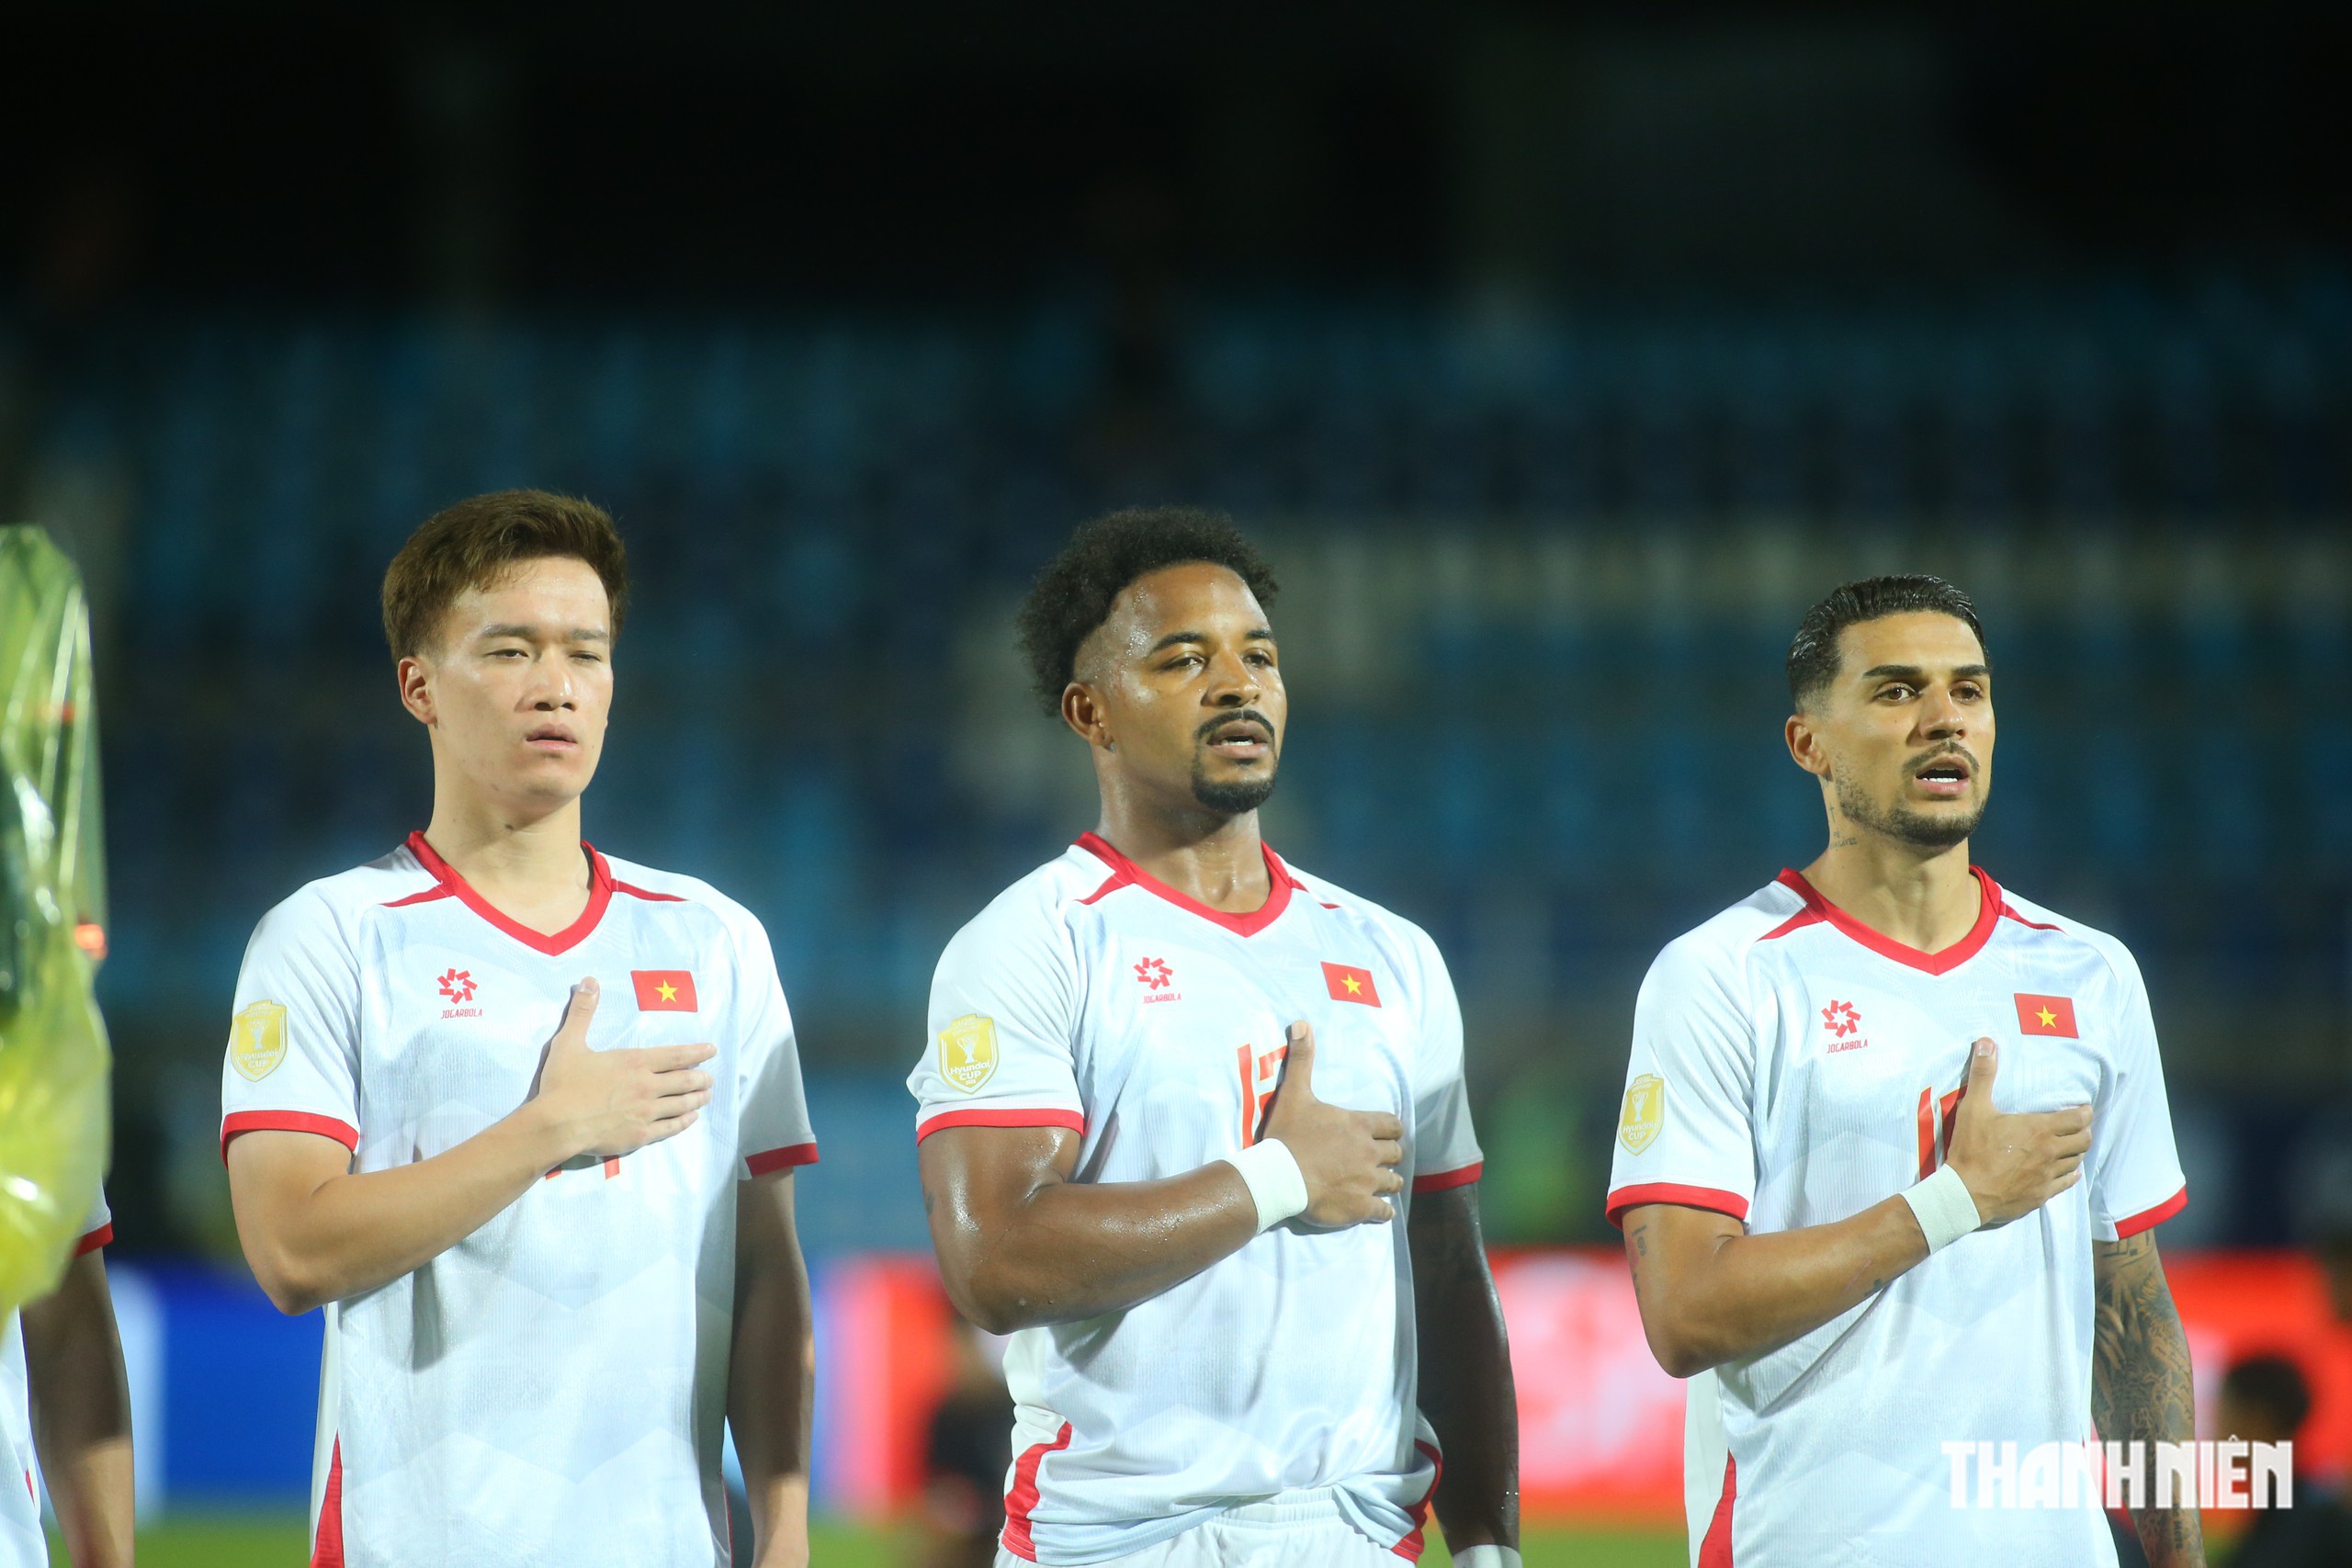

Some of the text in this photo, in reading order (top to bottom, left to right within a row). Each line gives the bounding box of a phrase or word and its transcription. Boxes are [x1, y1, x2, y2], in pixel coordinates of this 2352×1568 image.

[950, 1059, 990, 1075] Hyundai
[959, 1070, 981, 1080] CUP
[1628, 1131, 1646, 1141] CUP
